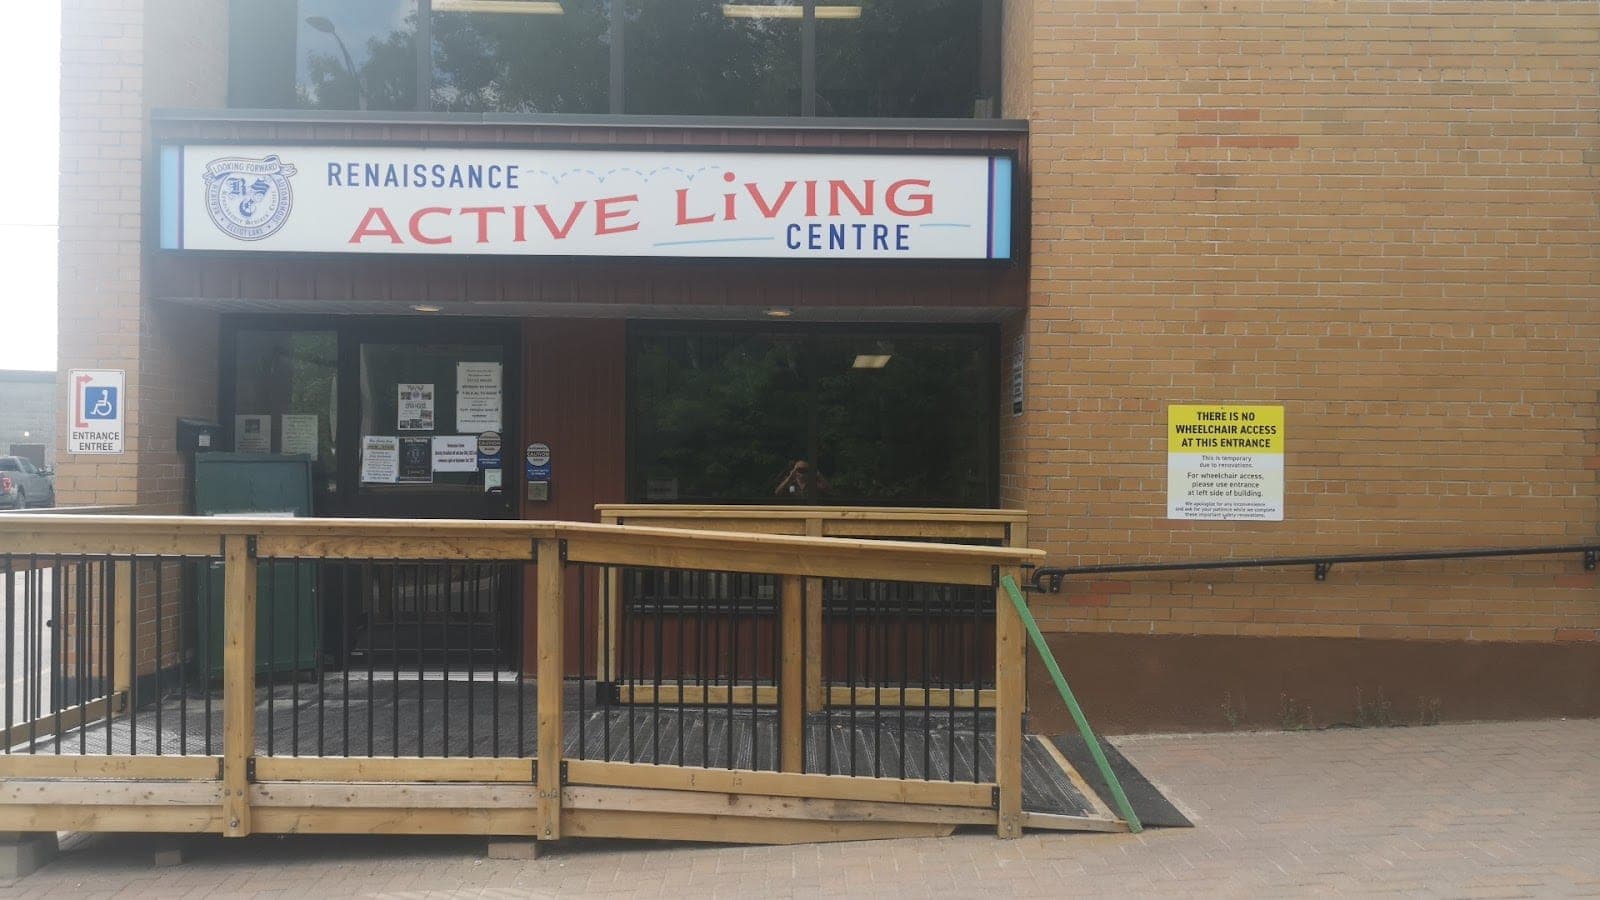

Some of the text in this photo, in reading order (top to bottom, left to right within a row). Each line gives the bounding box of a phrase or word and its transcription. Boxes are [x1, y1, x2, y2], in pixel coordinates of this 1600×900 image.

[212, 161, 278, 174] LOOKING FORWARD
[327, 162, 519, 189] RENAISSANCE
[348, 194, 640, 245] ACTIVE
[786, 223, 910, 250] CENTRE
[1197, 412, 1255, 421] THERE IS NO
[1176, 425, 1277, 435] WHEELCHAIR ACCESS
[72, 431, 120, 441] ENTRANCE
[1181, 438, 1271, 448] AT THIS ENTRANCE
[1234, 490, 1264, 498] building.
